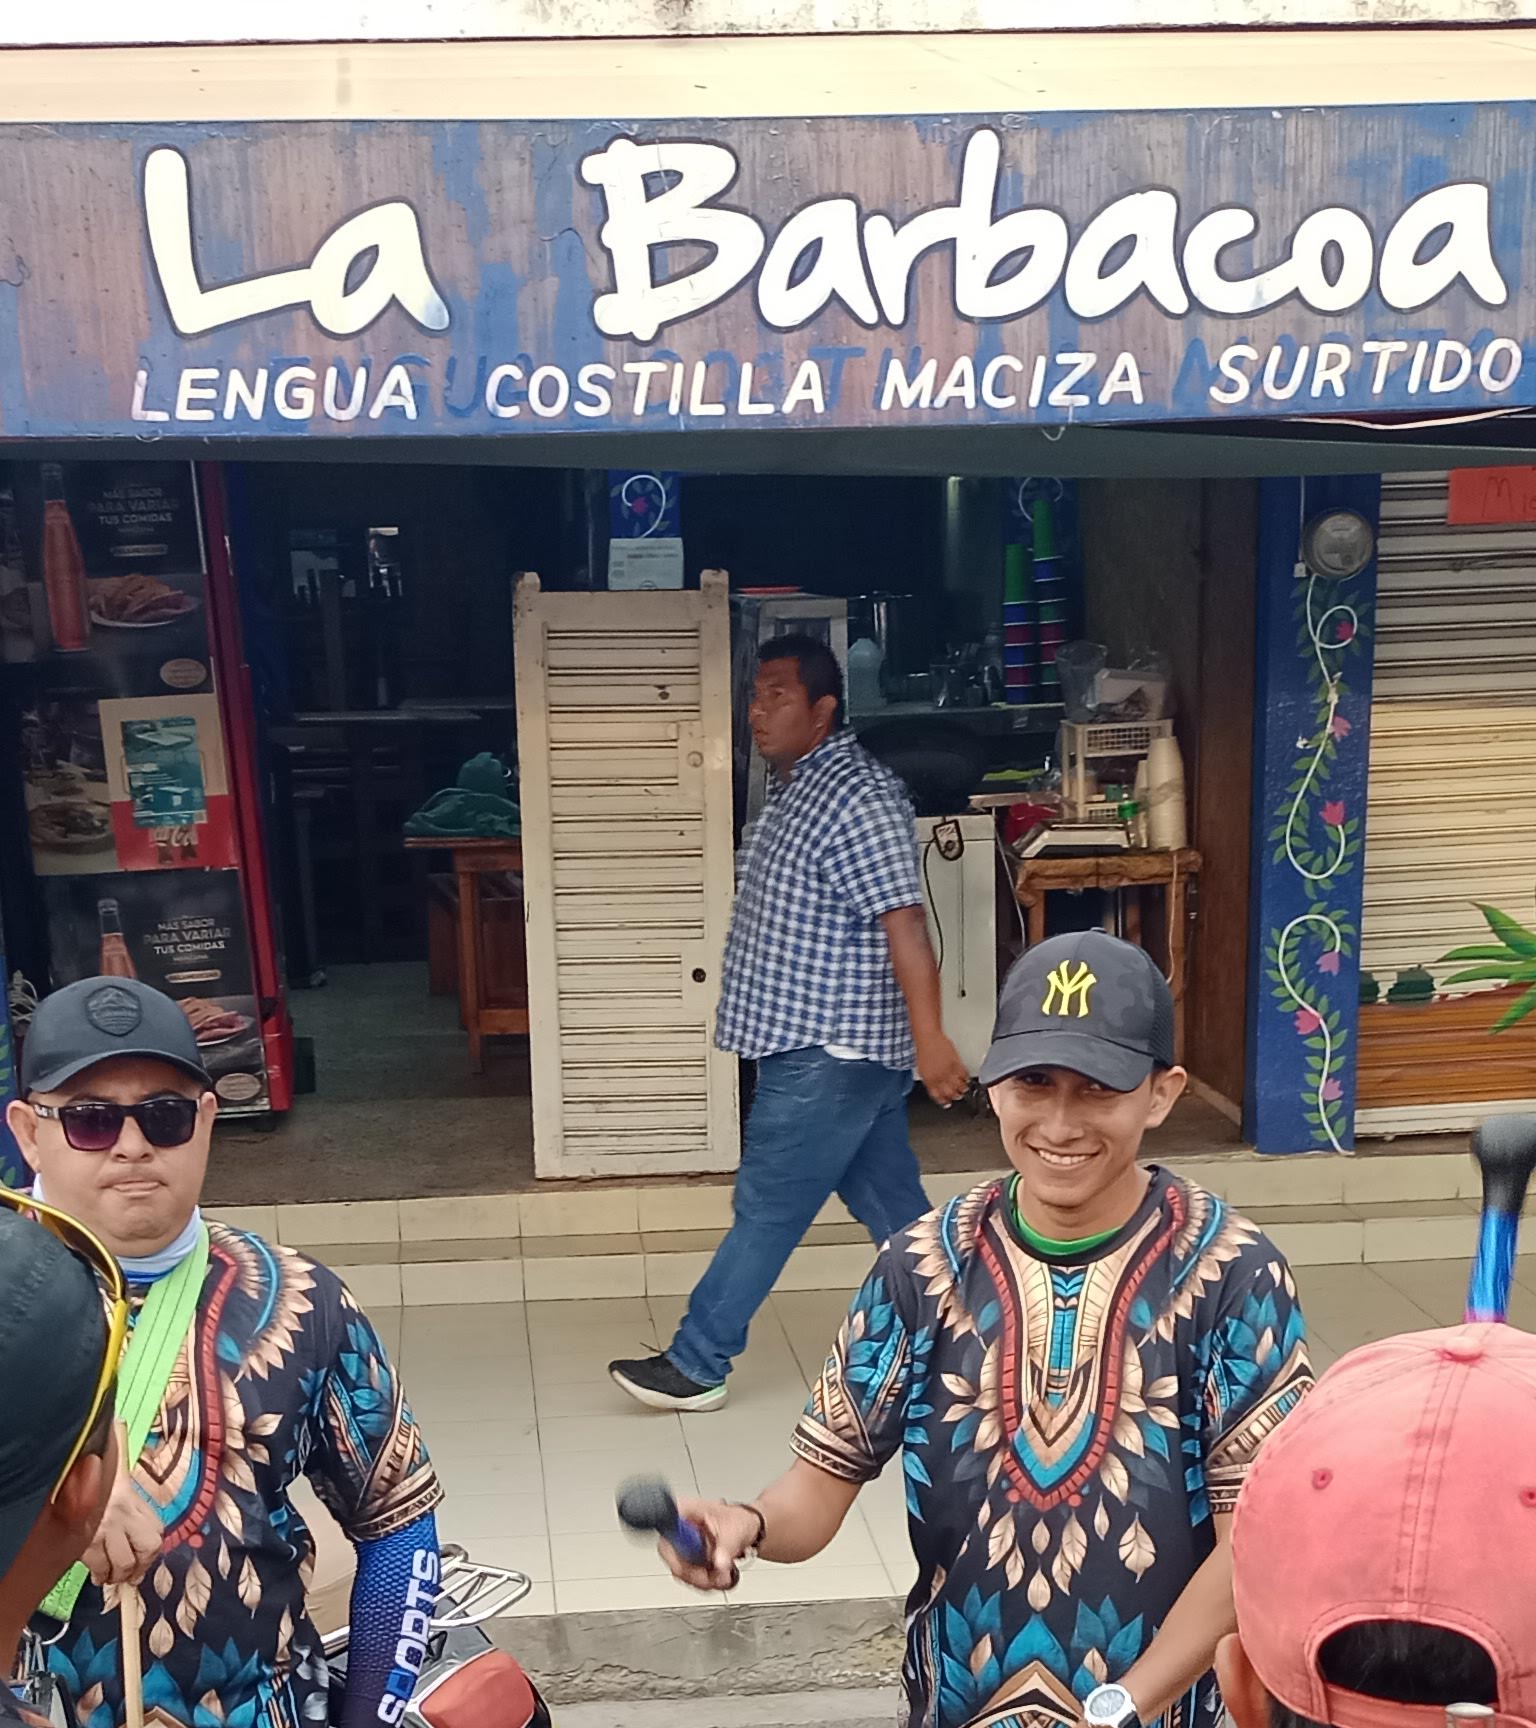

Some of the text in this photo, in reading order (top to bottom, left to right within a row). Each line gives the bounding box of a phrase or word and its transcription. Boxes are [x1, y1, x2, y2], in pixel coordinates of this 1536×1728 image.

[143, 146, 451, 335] La
[579, 127, 1508, 341] Barbacoa
[131, 363, 418, 422] LENGUA
[485, 361, 827, 418] COSTILLA
[880, 352, 1143, 411] MACIZA
[1209, 338, 1522, 404] SURTIDO
